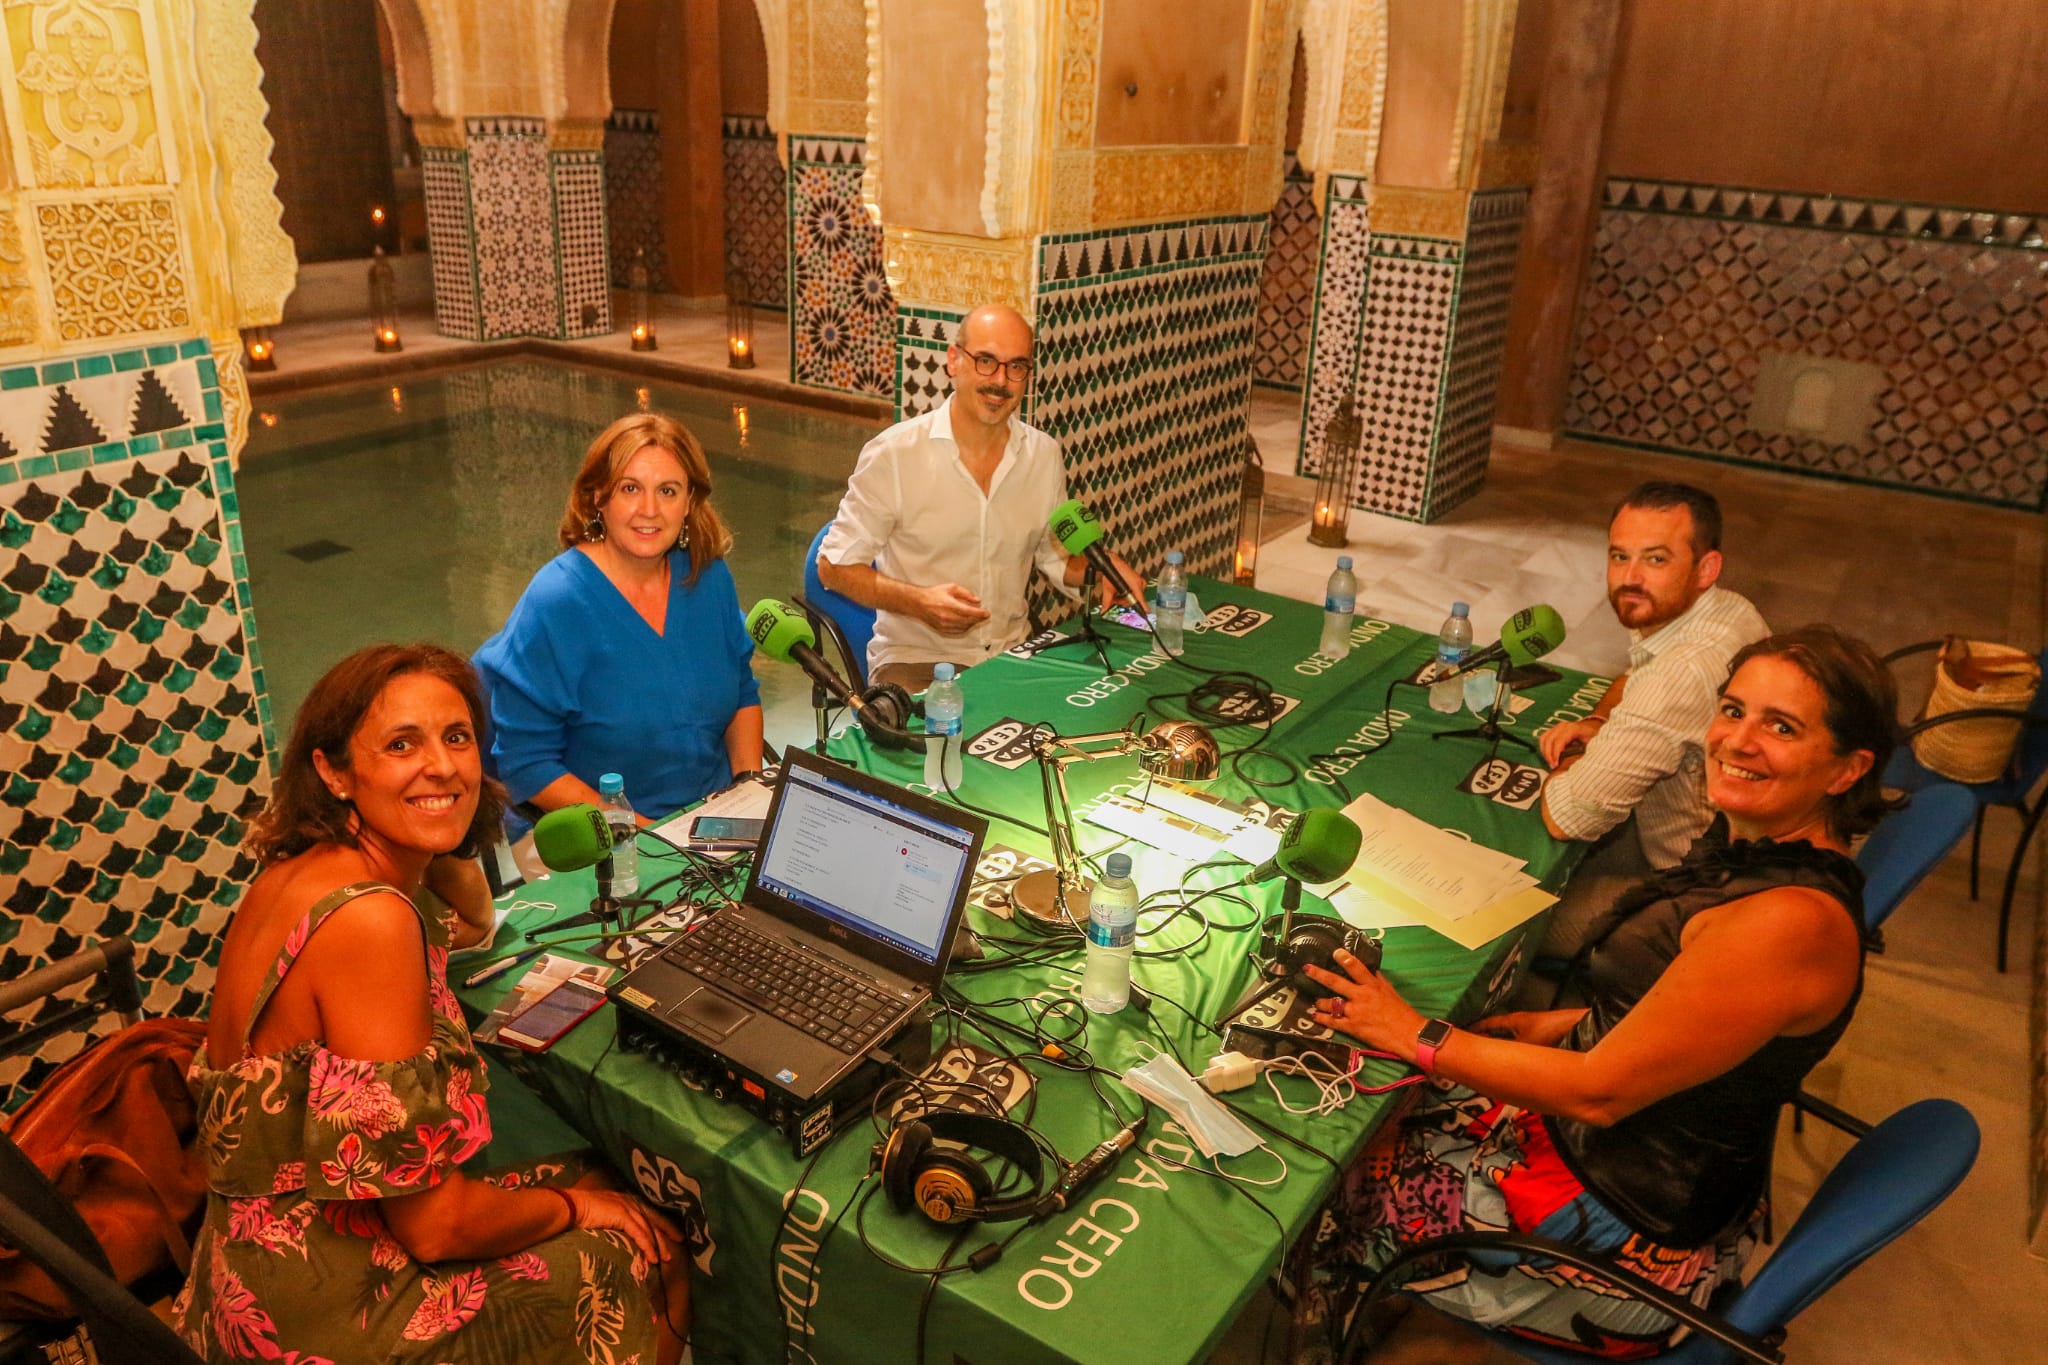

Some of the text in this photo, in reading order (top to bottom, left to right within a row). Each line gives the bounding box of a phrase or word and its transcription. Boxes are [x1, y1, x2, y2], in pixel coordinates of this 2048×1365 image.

[1350, 620, 1390, 648] OND
[1065, 674, 1130, 707] CERO
[974, 727, 1018, 751] CERO
[1346, 709, 1411, 746] ONDA
[1504, 772, 1538, 800] ONDA
[1017, 1197, 1140, 1311] CERO
